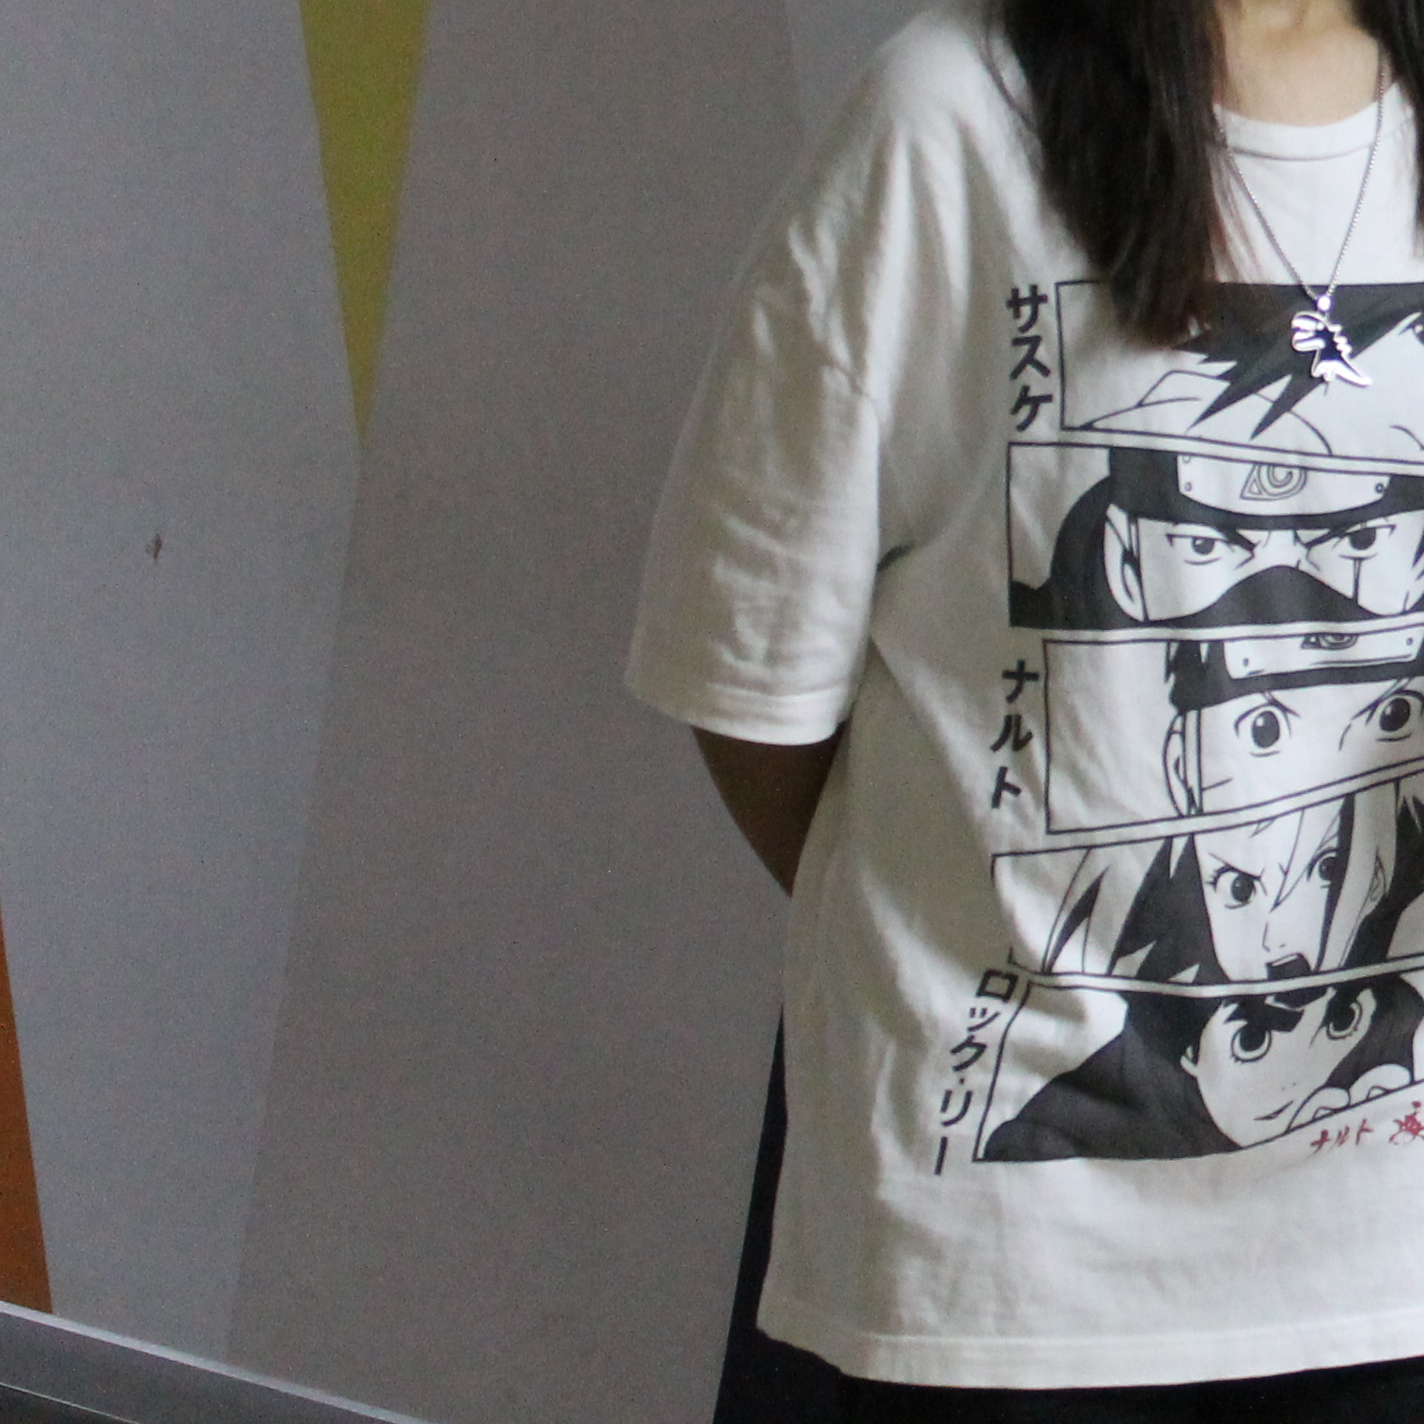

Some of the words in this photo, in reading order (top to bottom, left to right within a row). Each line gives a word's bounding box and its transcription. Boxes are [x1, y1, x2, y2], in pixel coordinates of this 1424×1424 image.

[1005, 283, 1054, 433] サスケ
[989, 657, 1041, 810] ナルト
[1306, 1118, 1374, 1159] ナルト
